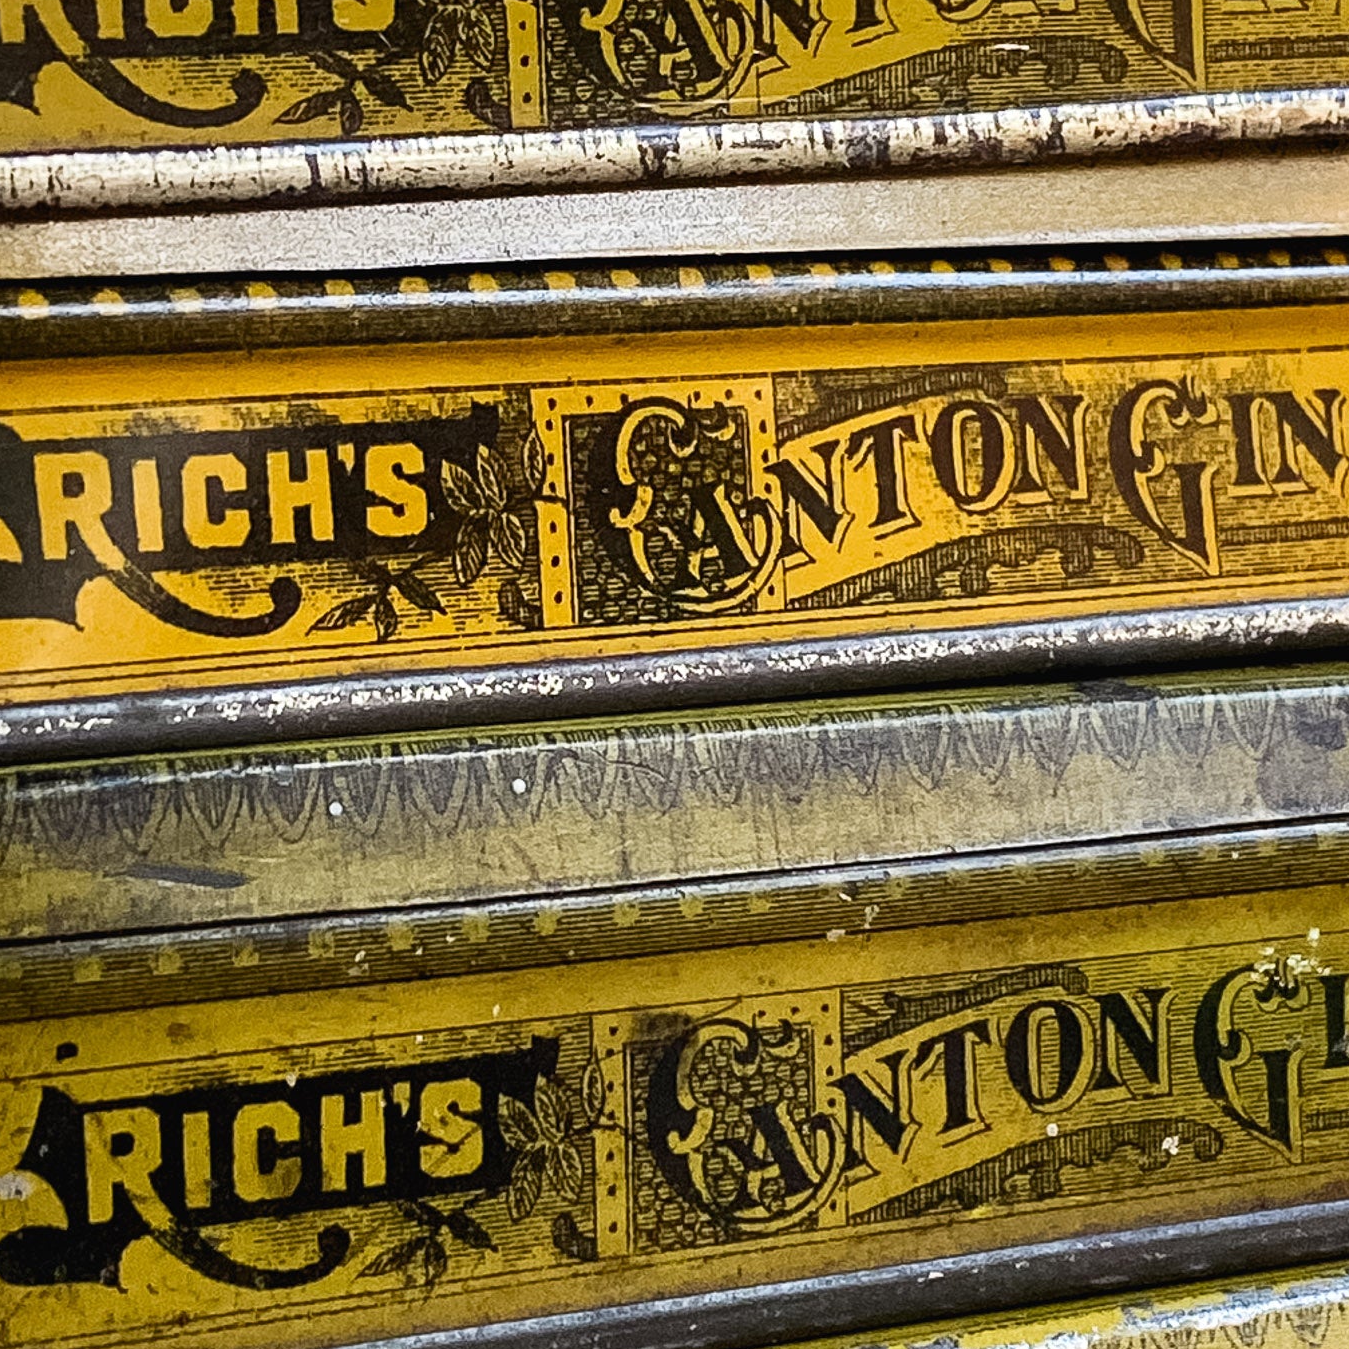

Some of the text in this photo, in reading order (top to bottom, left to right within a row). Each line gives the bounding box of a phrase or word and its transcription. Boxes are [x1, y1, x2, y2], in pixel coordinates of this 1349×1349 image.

[34, 441, 429, 587] RICH'S
[597, 393, 1091, 613] CANTON
[83, 1077, 486, 1247] RICH'S
[650, 986, 1177, 1233] CANTON
